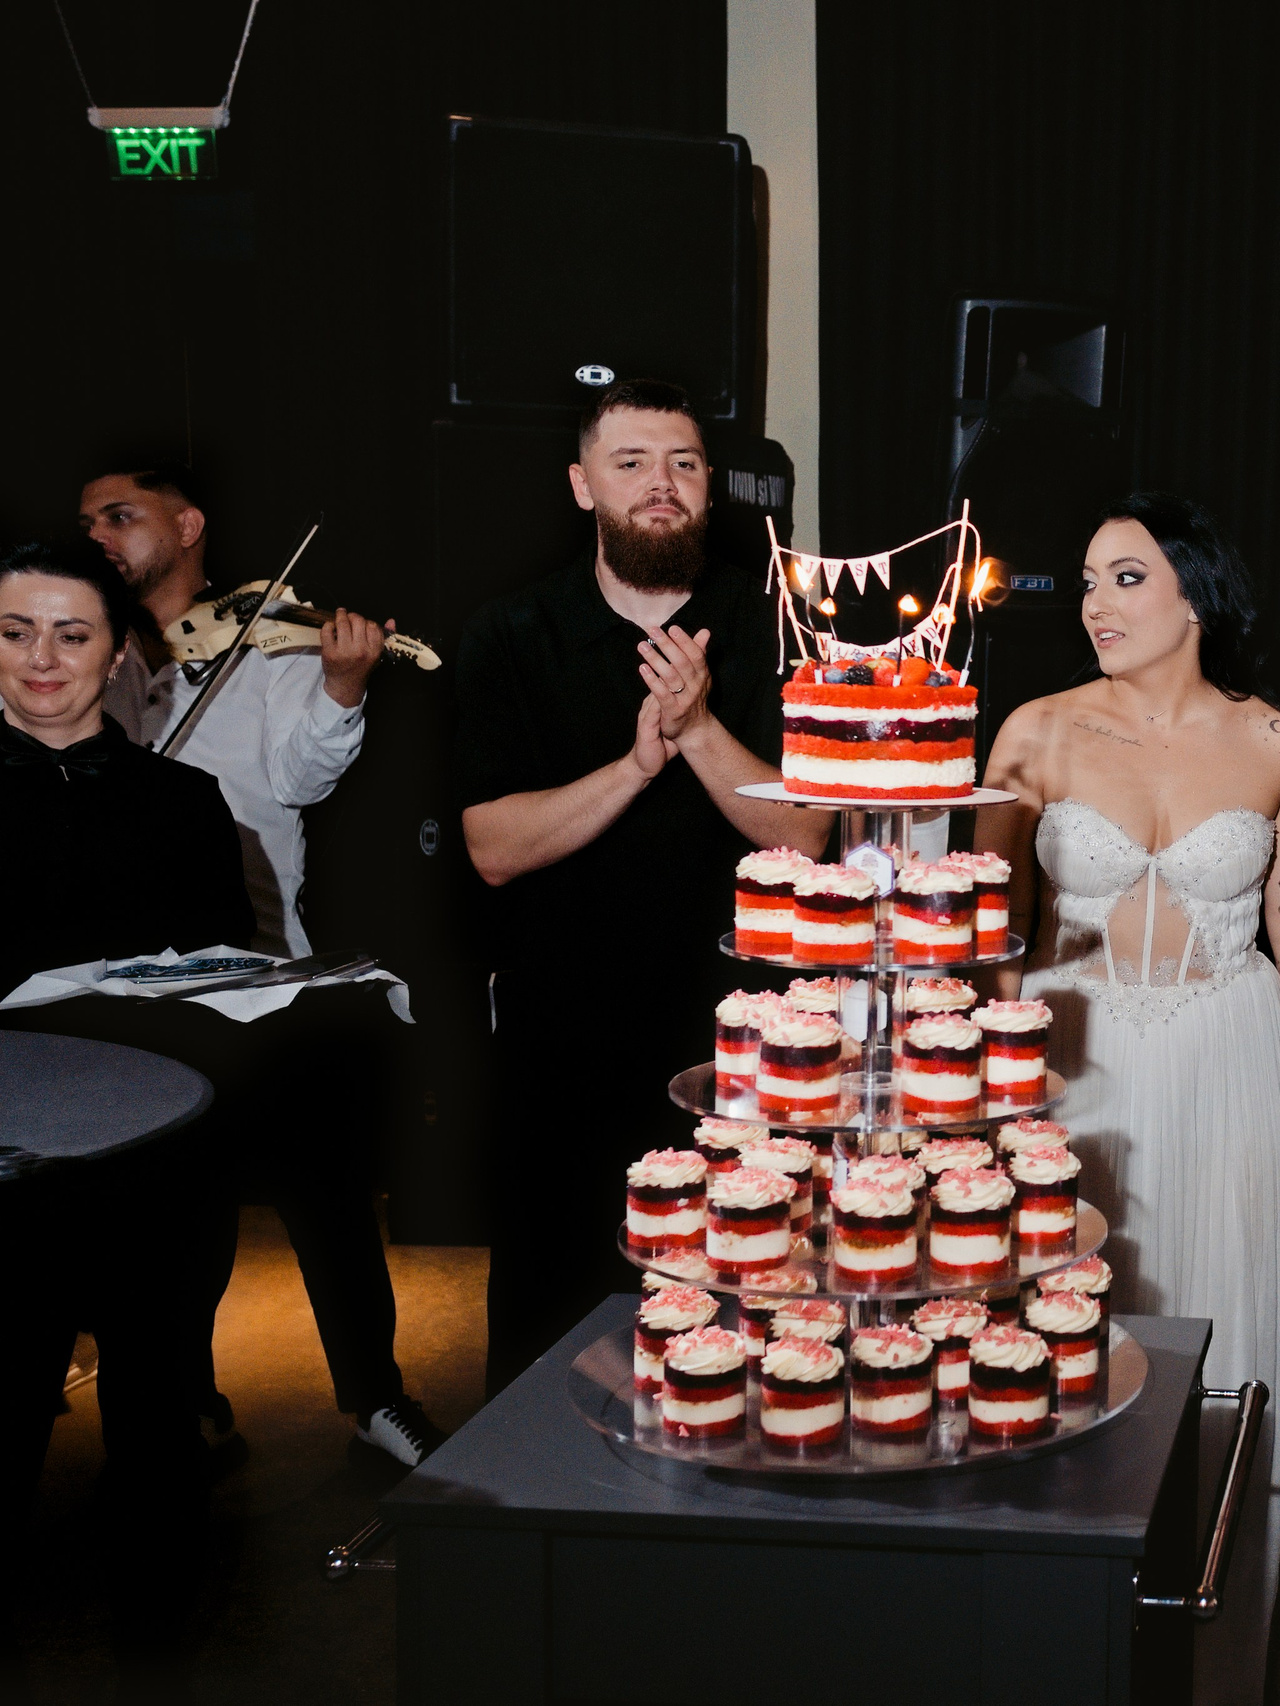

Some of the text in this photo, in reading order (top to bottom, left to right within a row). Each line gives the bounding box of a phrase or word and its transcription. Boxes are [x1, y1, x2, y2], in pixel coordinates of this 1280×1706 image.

[116, 138, 206, 175] EXIT
[805, 561, 887, 578] JUST
[1014, 577, 1049, 589] FBT
[260, 635, 293, 649] ZETA
